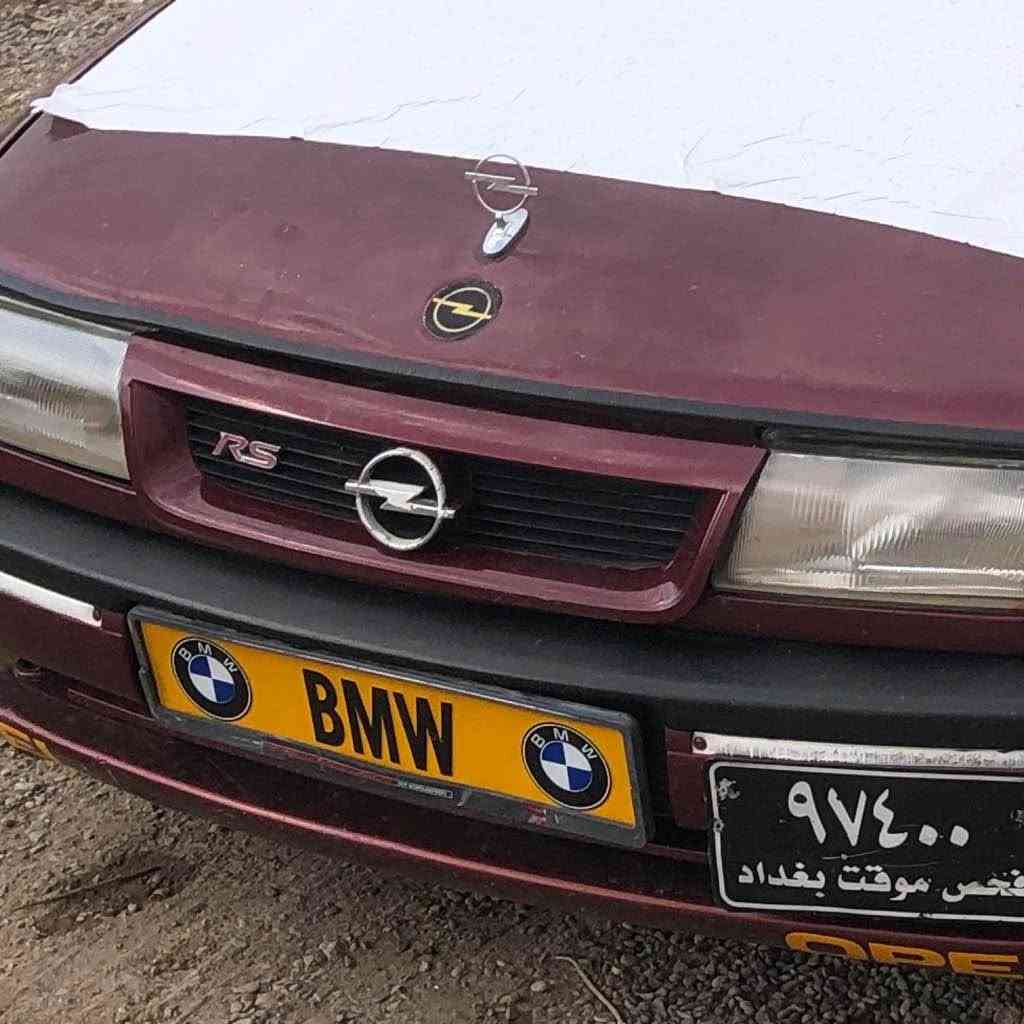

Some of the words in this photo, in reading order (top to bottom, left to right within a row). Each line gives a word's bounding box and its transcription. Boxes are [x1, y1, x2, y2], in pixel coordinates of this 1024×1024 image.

[210, 431, 282, 470] RS
[178, 641, 238, 673] BMW
[302, 667, 454, 777] BMW
[530, 727, 598, 760] BMW
[787, 780, 970, 849] ٩٧٤٠٠
[737, 861, 826, 898] بغداد
